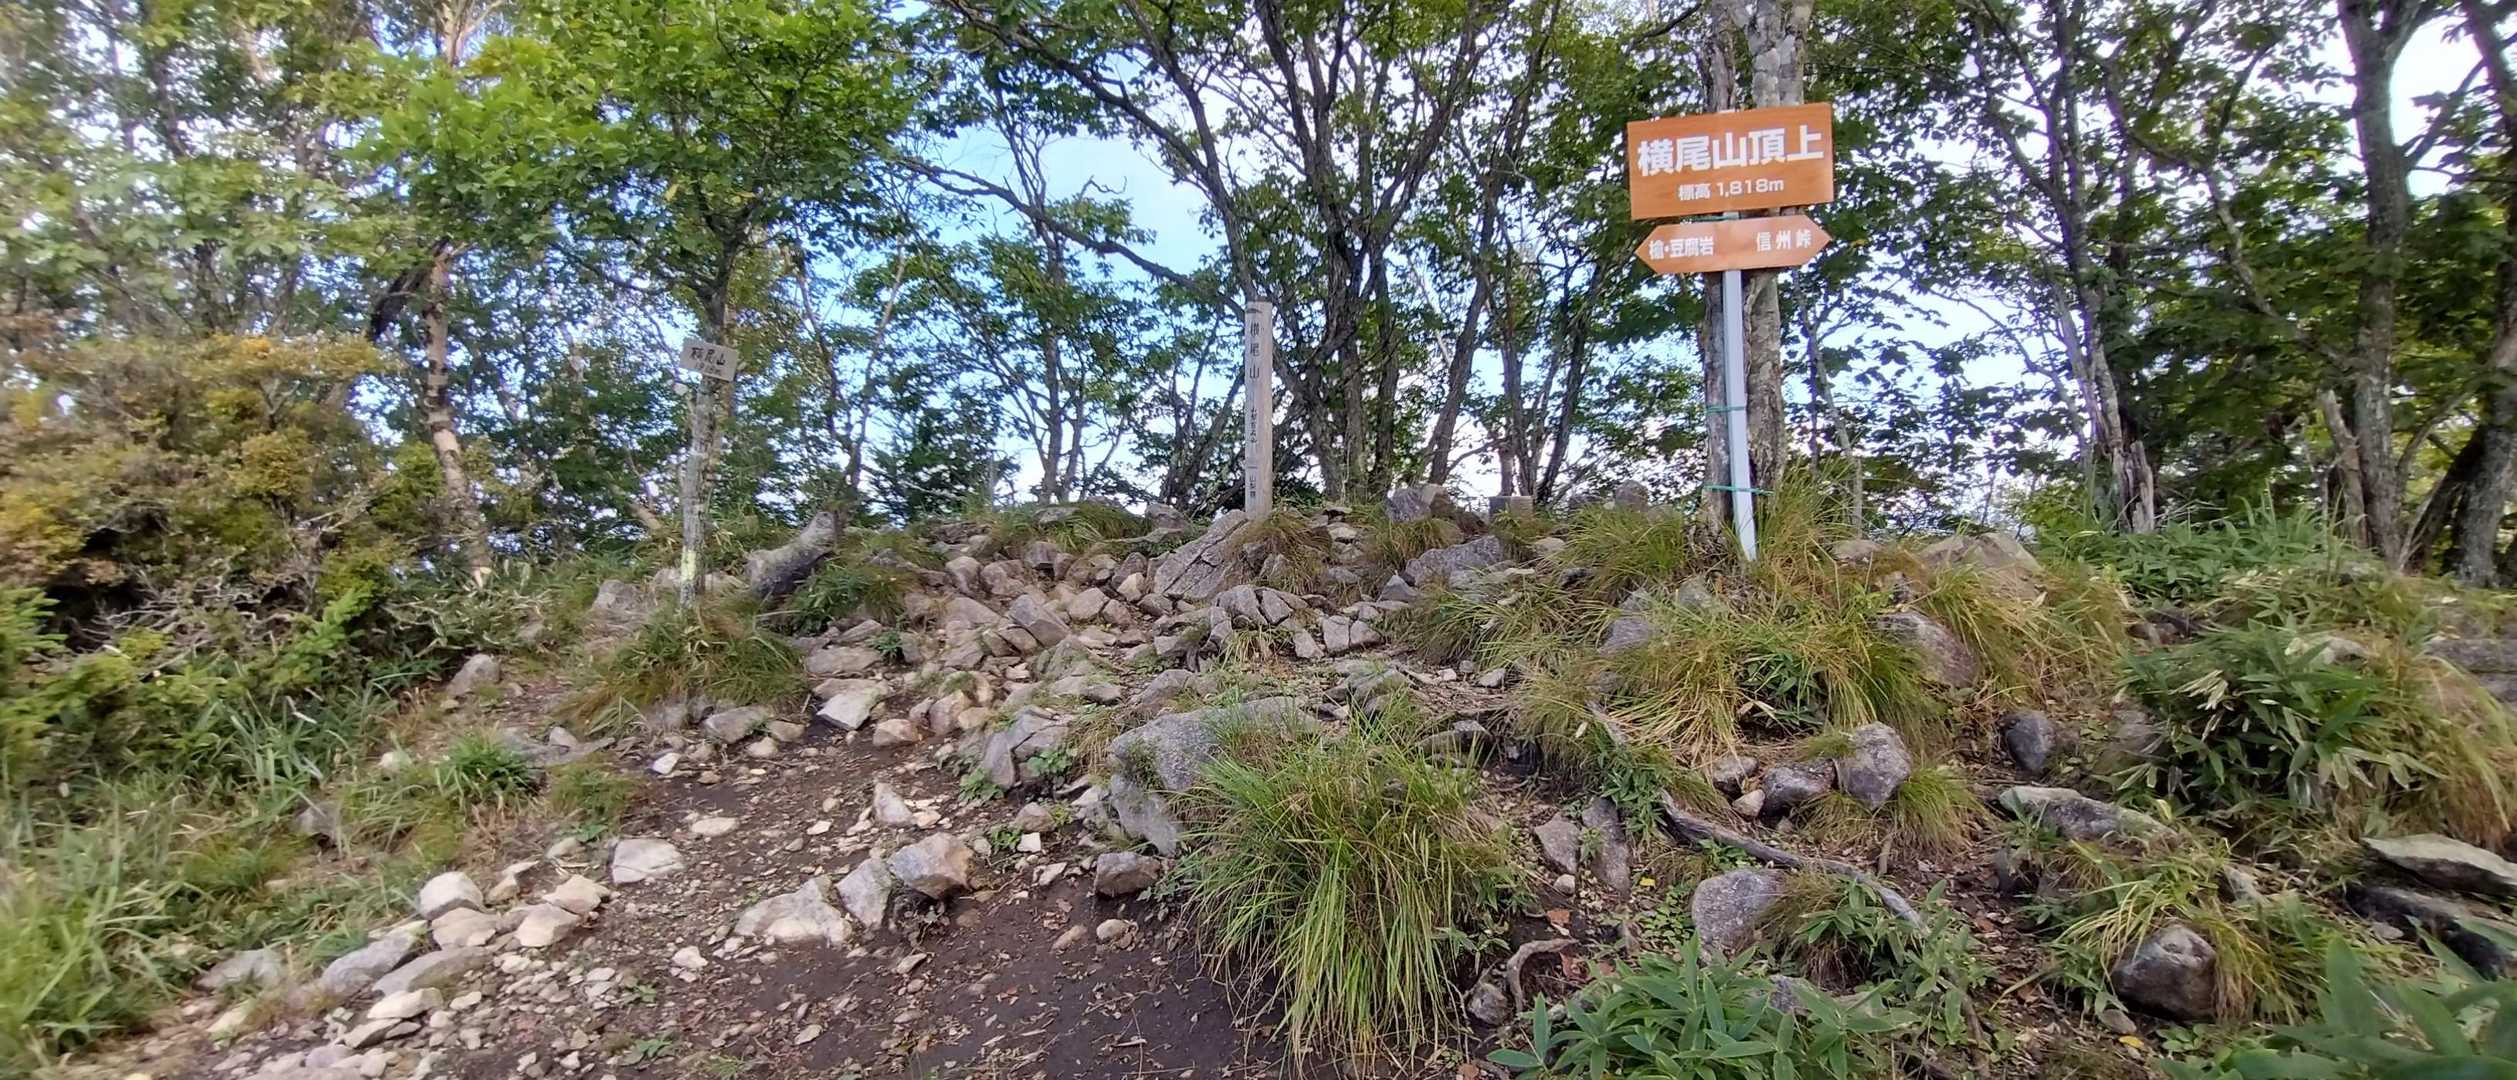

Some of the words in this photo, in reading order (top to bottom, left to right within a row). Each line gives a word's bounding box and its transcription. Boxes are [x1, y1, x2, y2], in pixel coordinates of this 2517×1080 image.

[1637, 125, 1824, 176] 横尾山頂上
[1678, 183, 1711, 200] 標高
[1716, 178, 1784, 197] 1,818m
[1756, 229, 1812, 252] 信州峠
[1249, 321, 1260, 379] 横尾山
